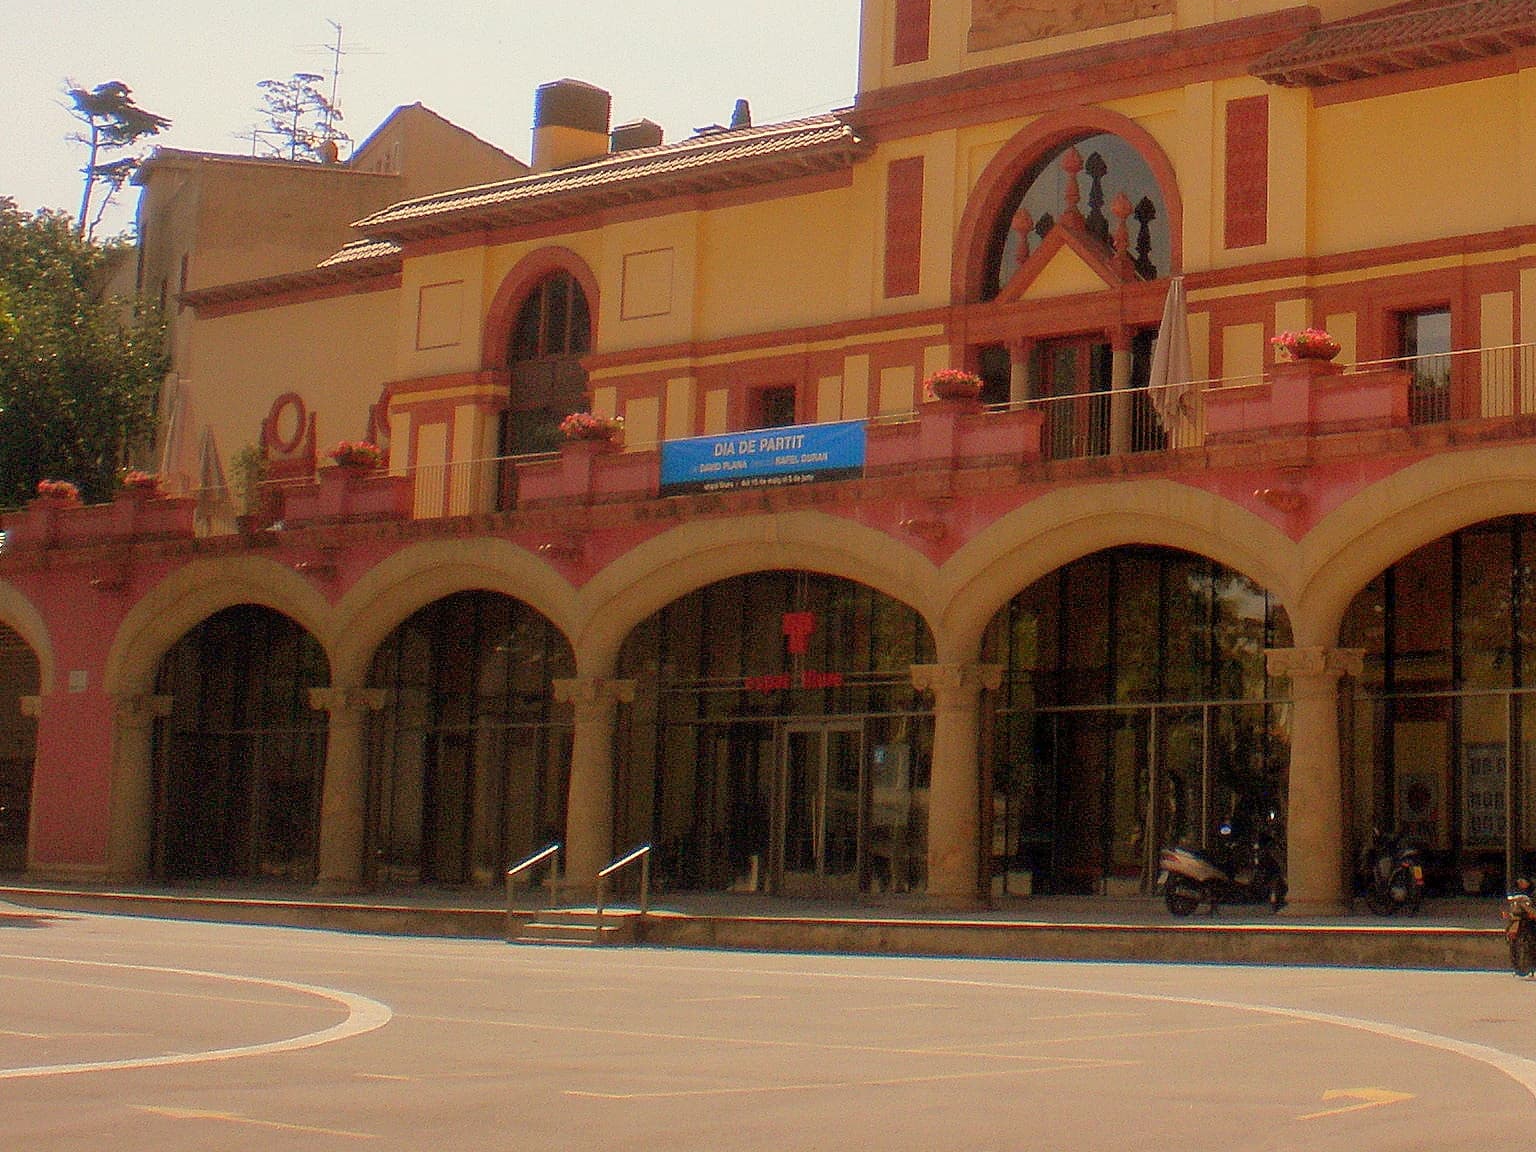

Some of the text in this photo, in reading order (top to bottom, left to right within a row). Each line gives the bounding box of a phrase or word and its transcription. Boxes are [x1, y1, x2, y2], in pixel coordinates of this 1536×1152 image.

[714, 434, 805, 457] DIA DE PARTIT
